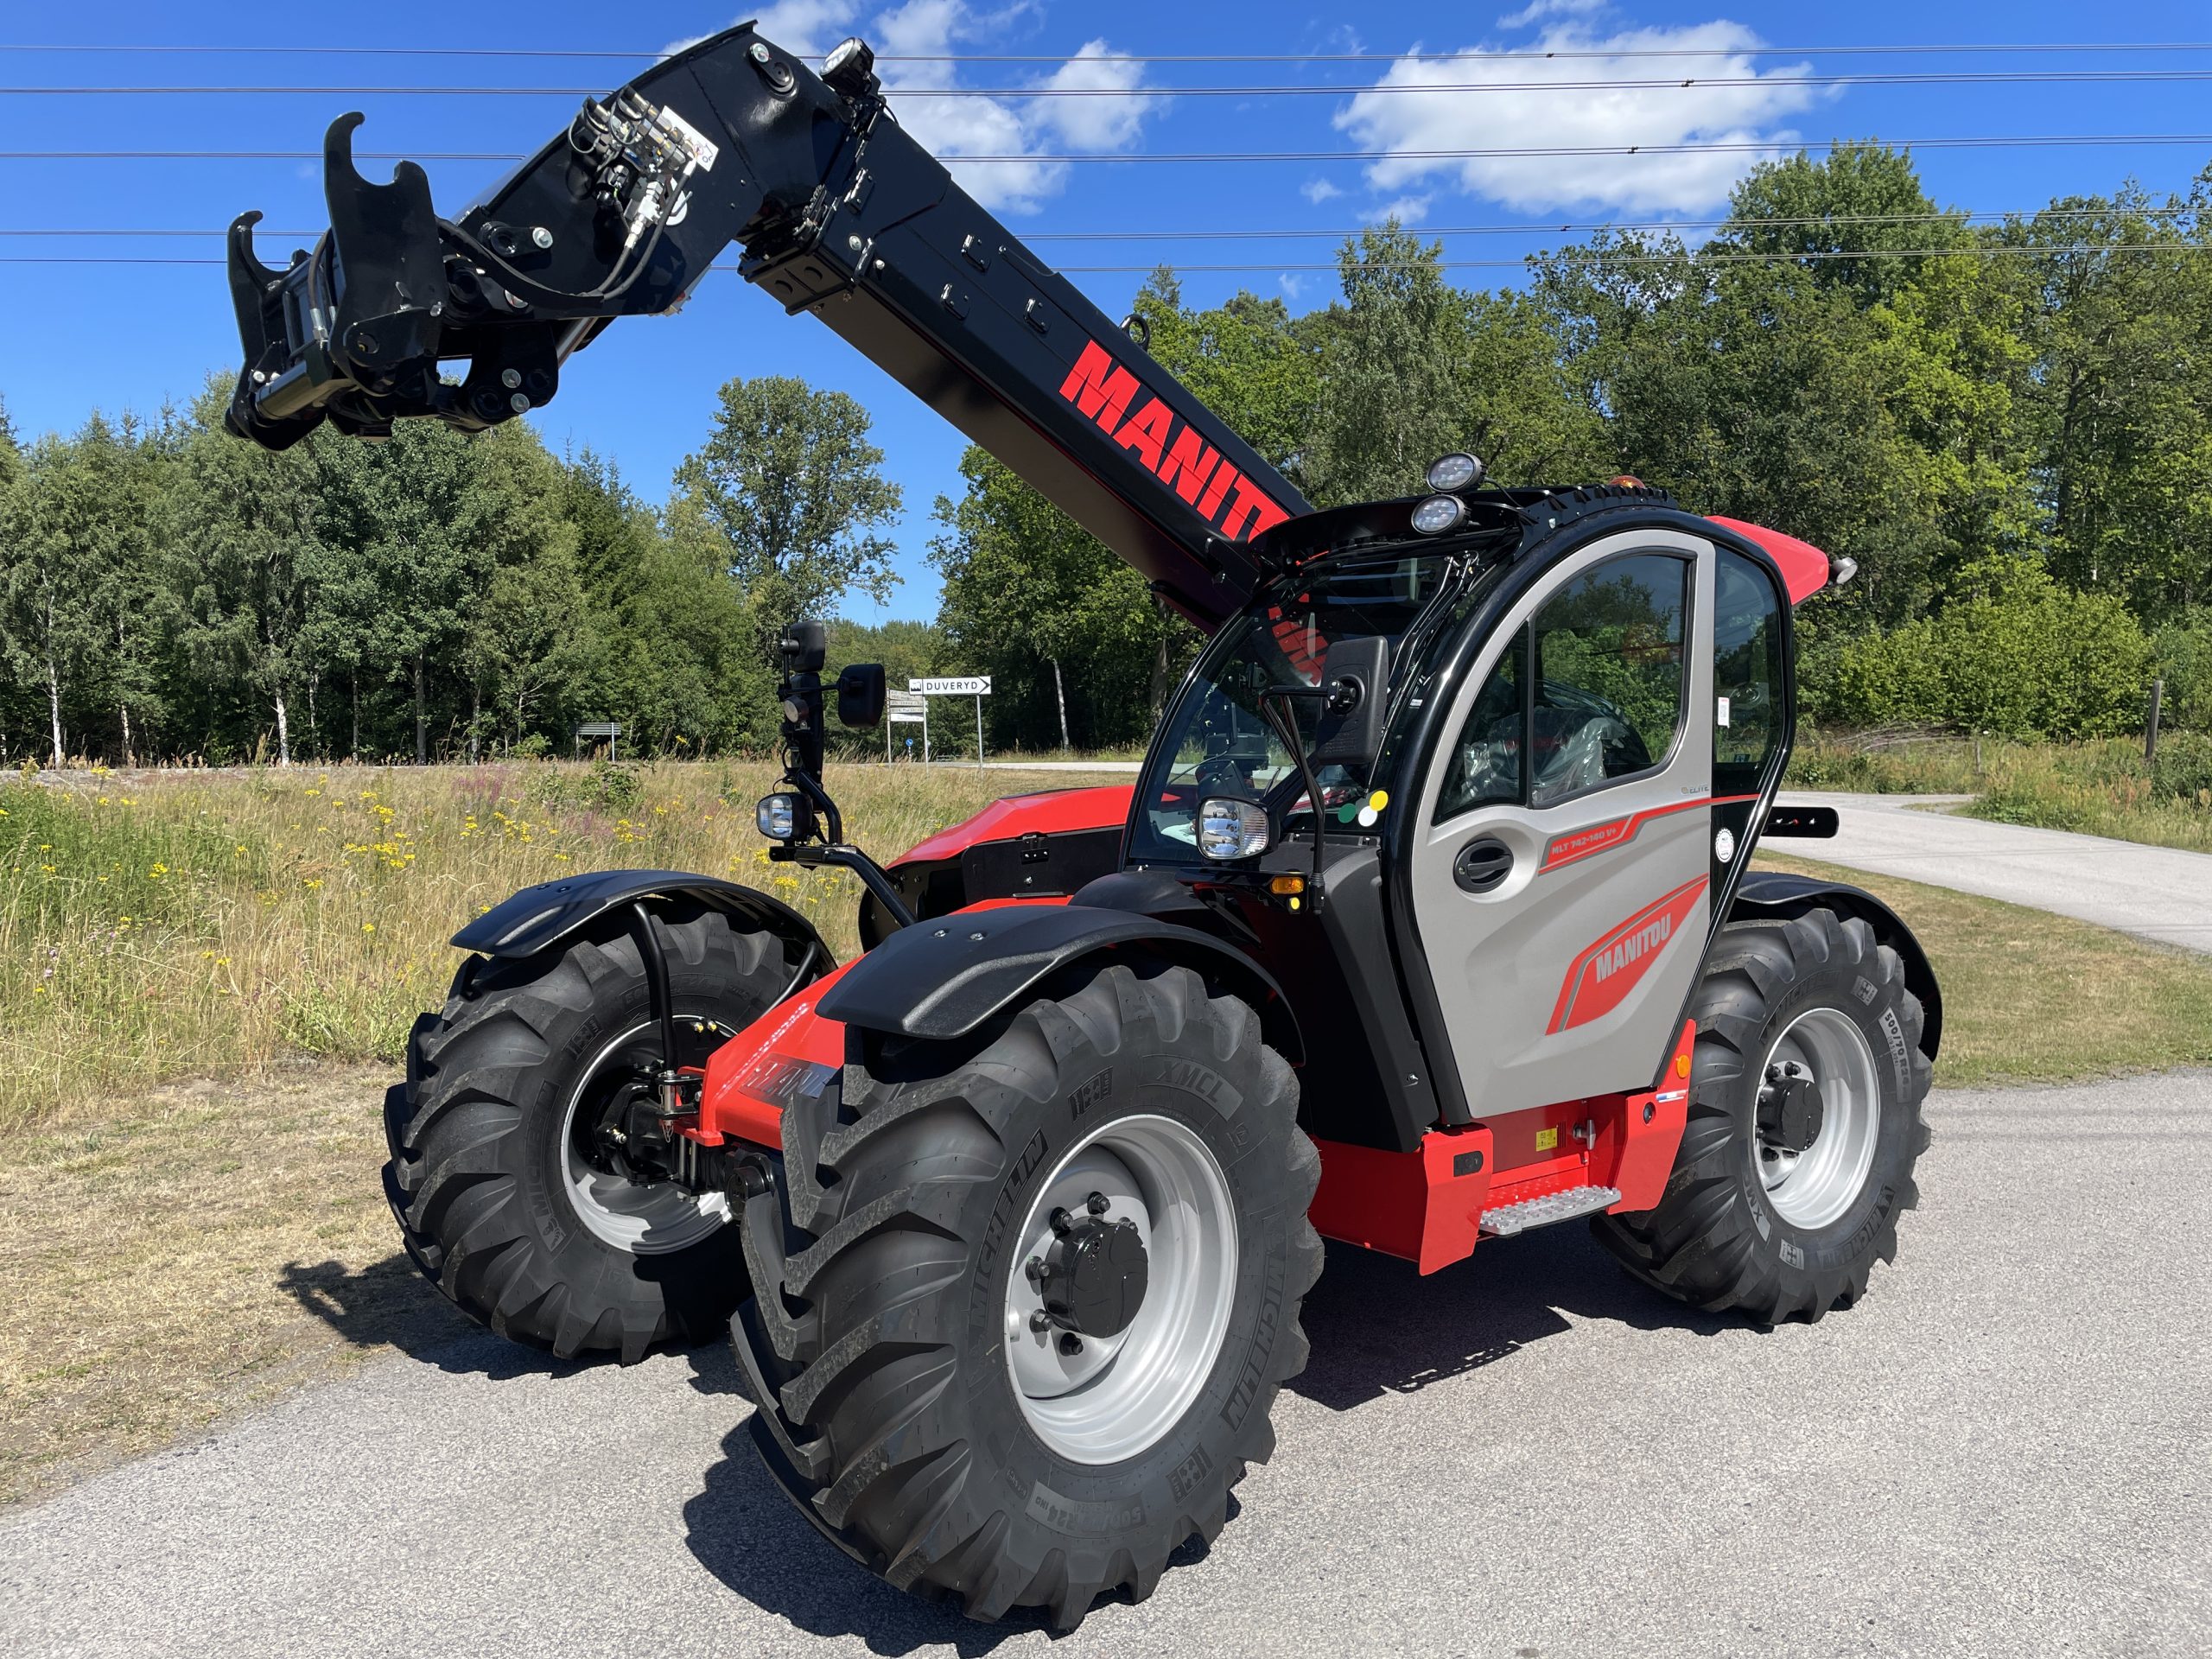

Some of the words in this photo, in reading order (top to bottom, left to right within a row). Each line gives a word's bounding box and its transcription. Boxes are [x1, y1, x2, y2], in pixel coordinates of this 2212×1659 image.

[926, 681, 978, 690] DUVERYD
[1552, 842, 1570, 855] MLT
[1570, 830, 1605, 849] 742-140
[1596, 912, 1672, 983] MANITOU
[1885, 1014, 1905, 1057] 500/70
[1156, 1061, 1224, 1103] XMCL
[969, 1135, 1046, 1329] MICHELIN
[1227, 1257, 1285, 1426] MICHELIN
